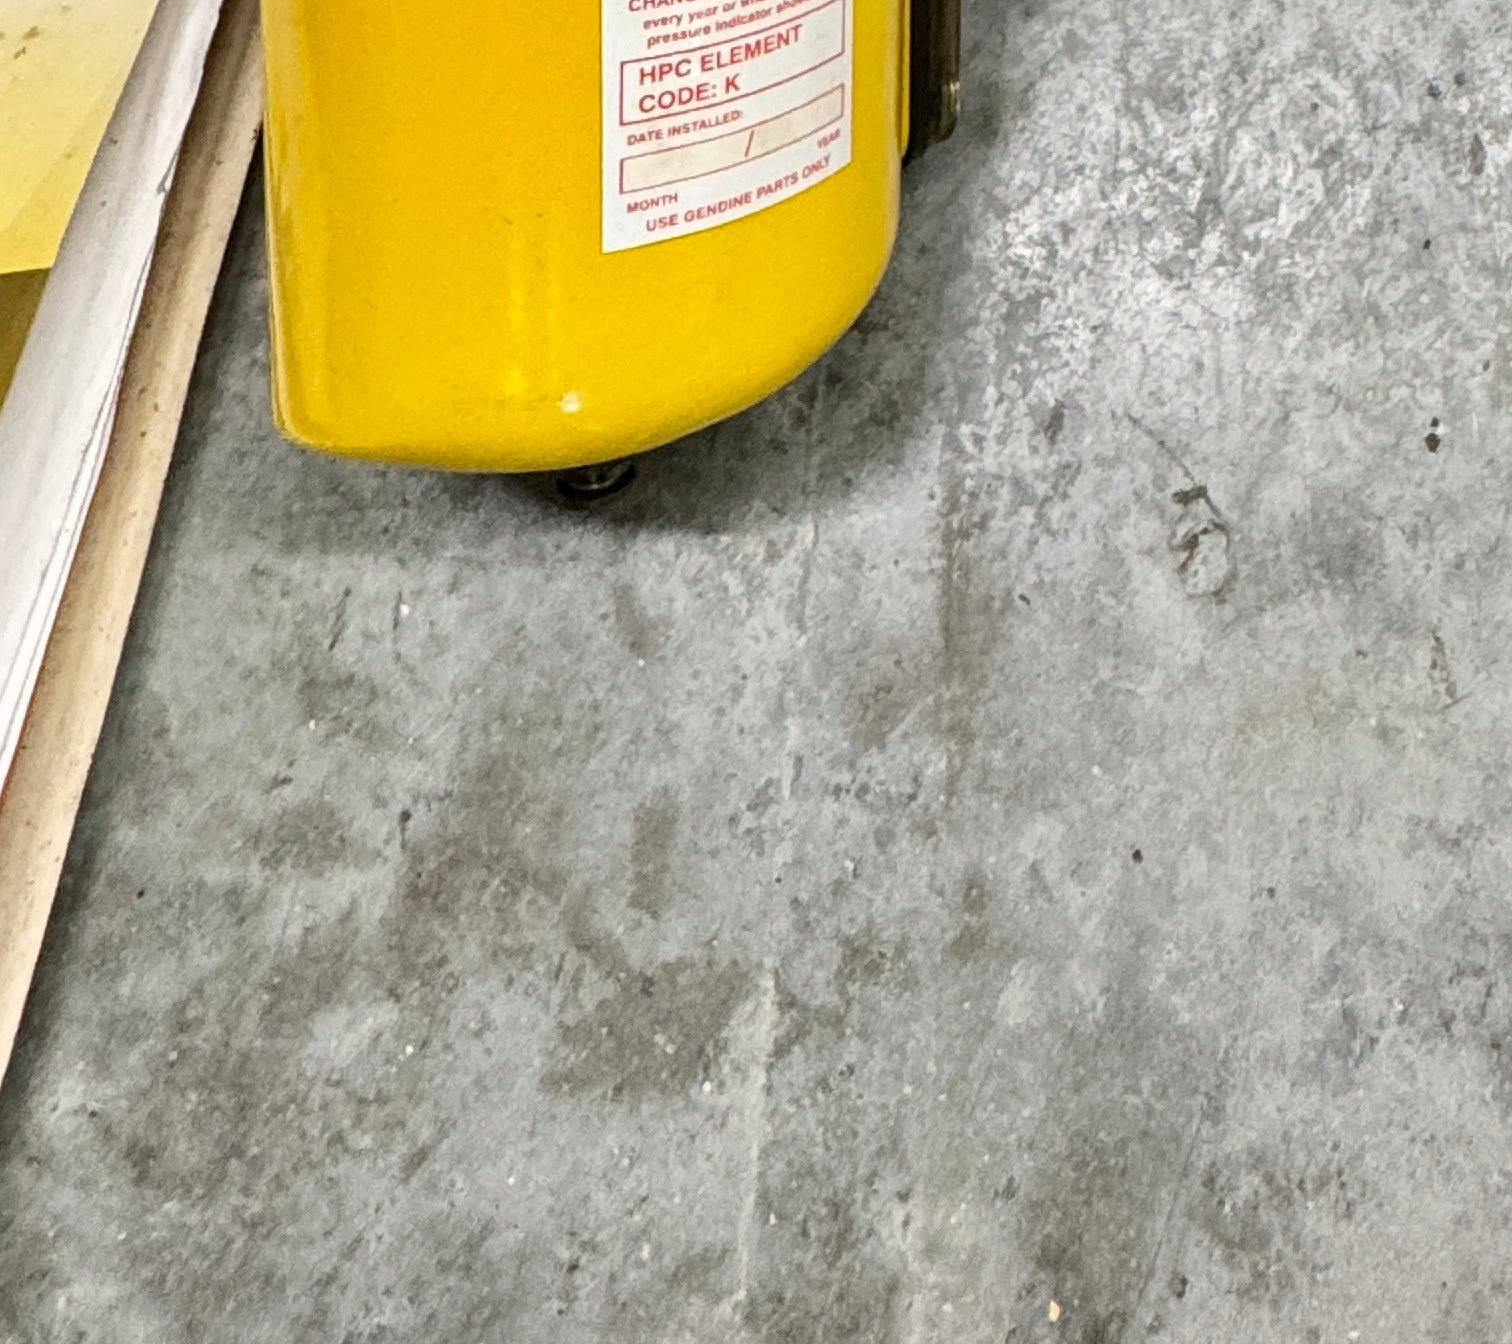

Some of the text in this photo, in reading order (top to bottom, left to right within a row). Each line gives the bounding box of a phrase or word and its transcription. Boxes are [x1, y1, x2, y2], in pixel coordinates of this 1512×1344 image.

[642, 12, 683, 30] every
[688, 4, 718, 25] year
[722, 0, 737, 13] or
[647, 24, 712, 49] pressure
[715, 5, 773, 32] indicator
[639, 23, 804, 86] HPC ELEMENT
[638, 72, 741, 114] CODE: K
[626, 128, 663, 146] DATE
[816, 128, 841, 150] YEAR
[626, 192, 679, 214] MONTH
[645, 214, 679, 232] USE
[756, 170, 800, 199] PARTS
[802, 153, 832, 179] ONLY
